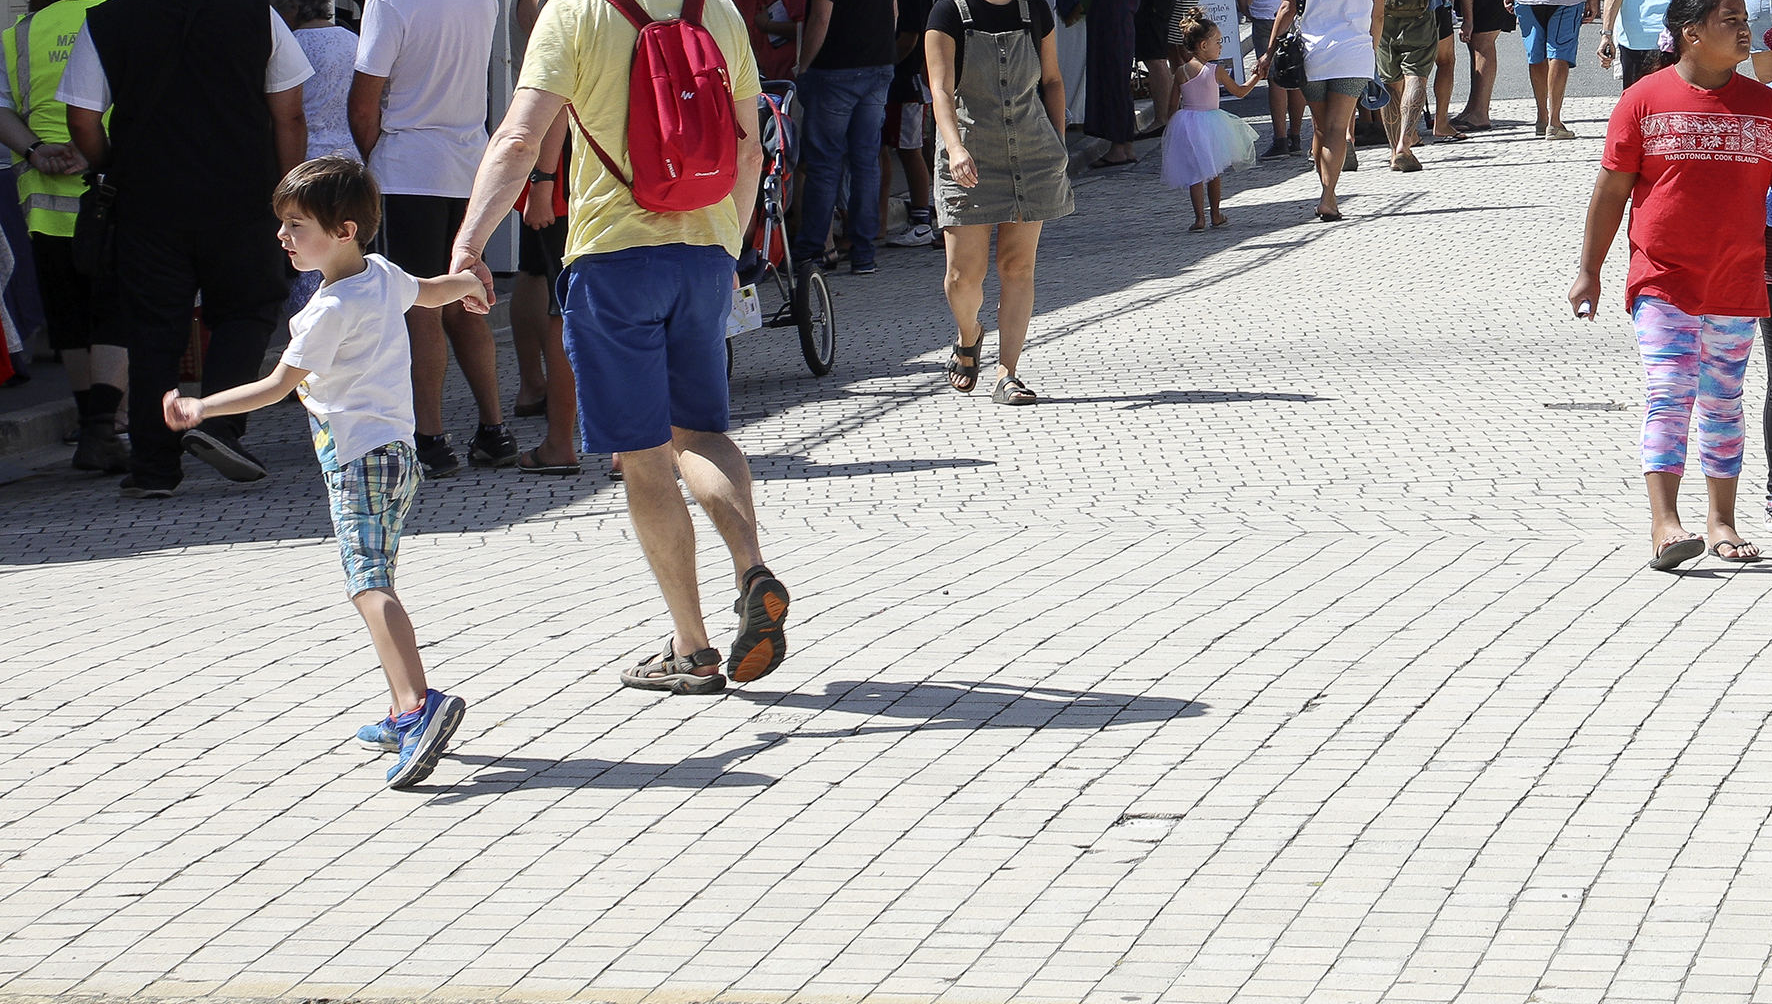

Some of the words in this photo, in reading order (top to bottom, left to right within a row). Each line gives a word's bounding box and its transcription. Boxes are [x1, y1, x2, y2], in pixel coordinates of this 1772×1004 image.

[1664, 153, 1712, 162] RAROTONGA
[1714, 153, 1733, 162] COOK
[1734, 155, 1760, 165] ISLANDS
